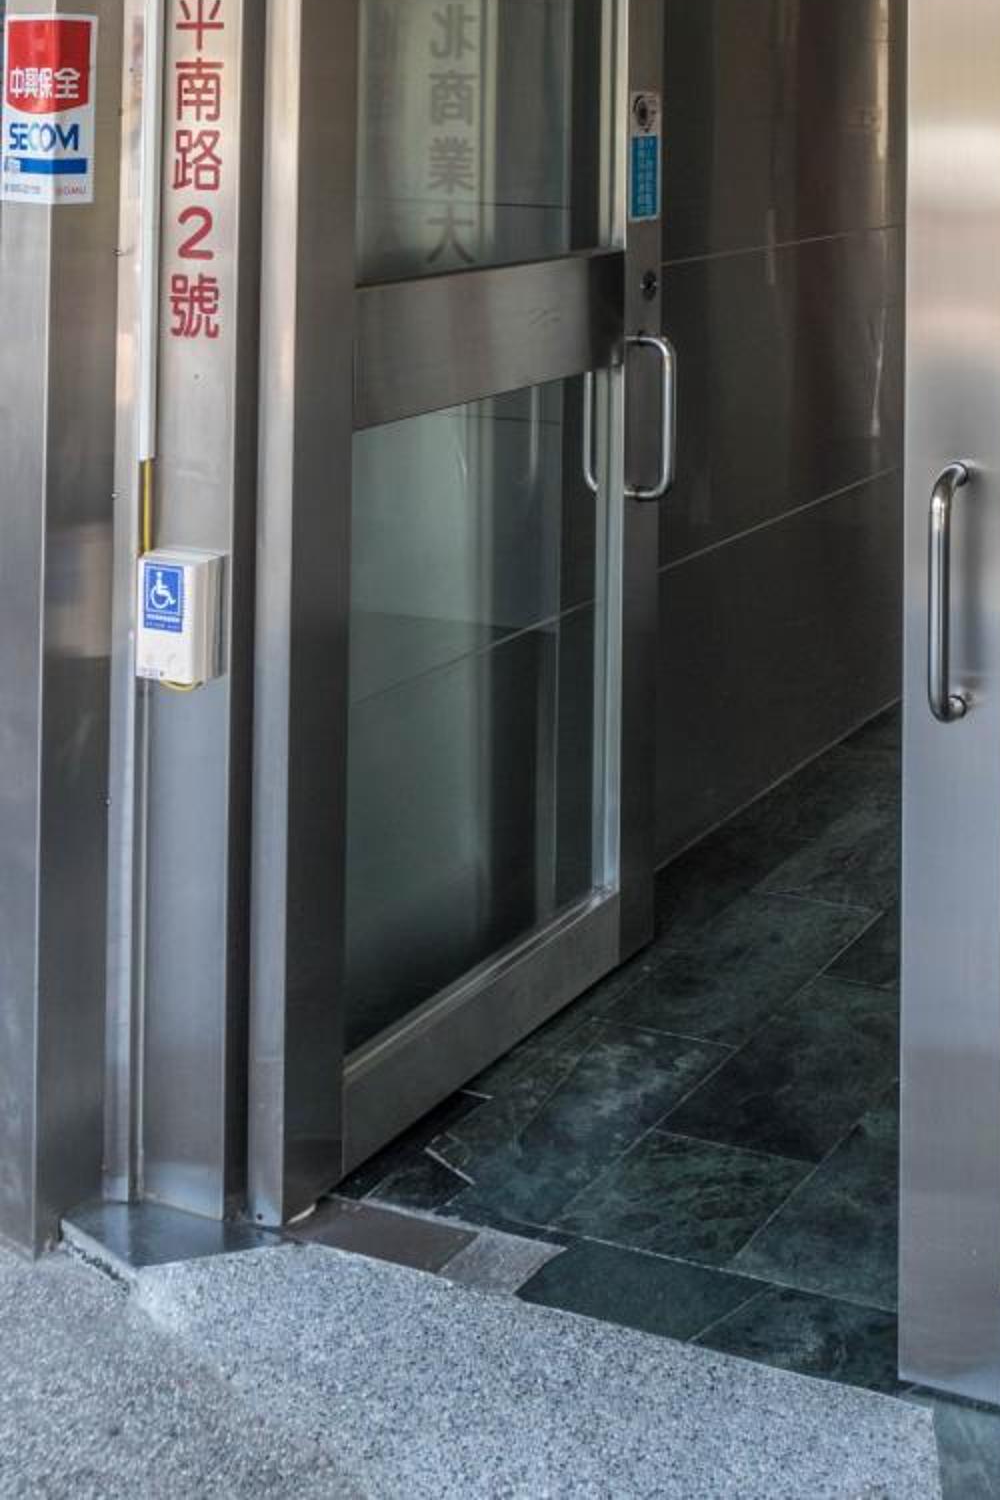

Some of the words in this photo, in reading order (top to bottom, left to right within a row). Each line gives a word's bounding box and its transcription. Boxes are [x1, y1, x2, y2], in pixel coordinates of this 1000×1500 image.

[9, 67, 80, 99] 中興保全
[9, 123, 80, 151] SECOM
